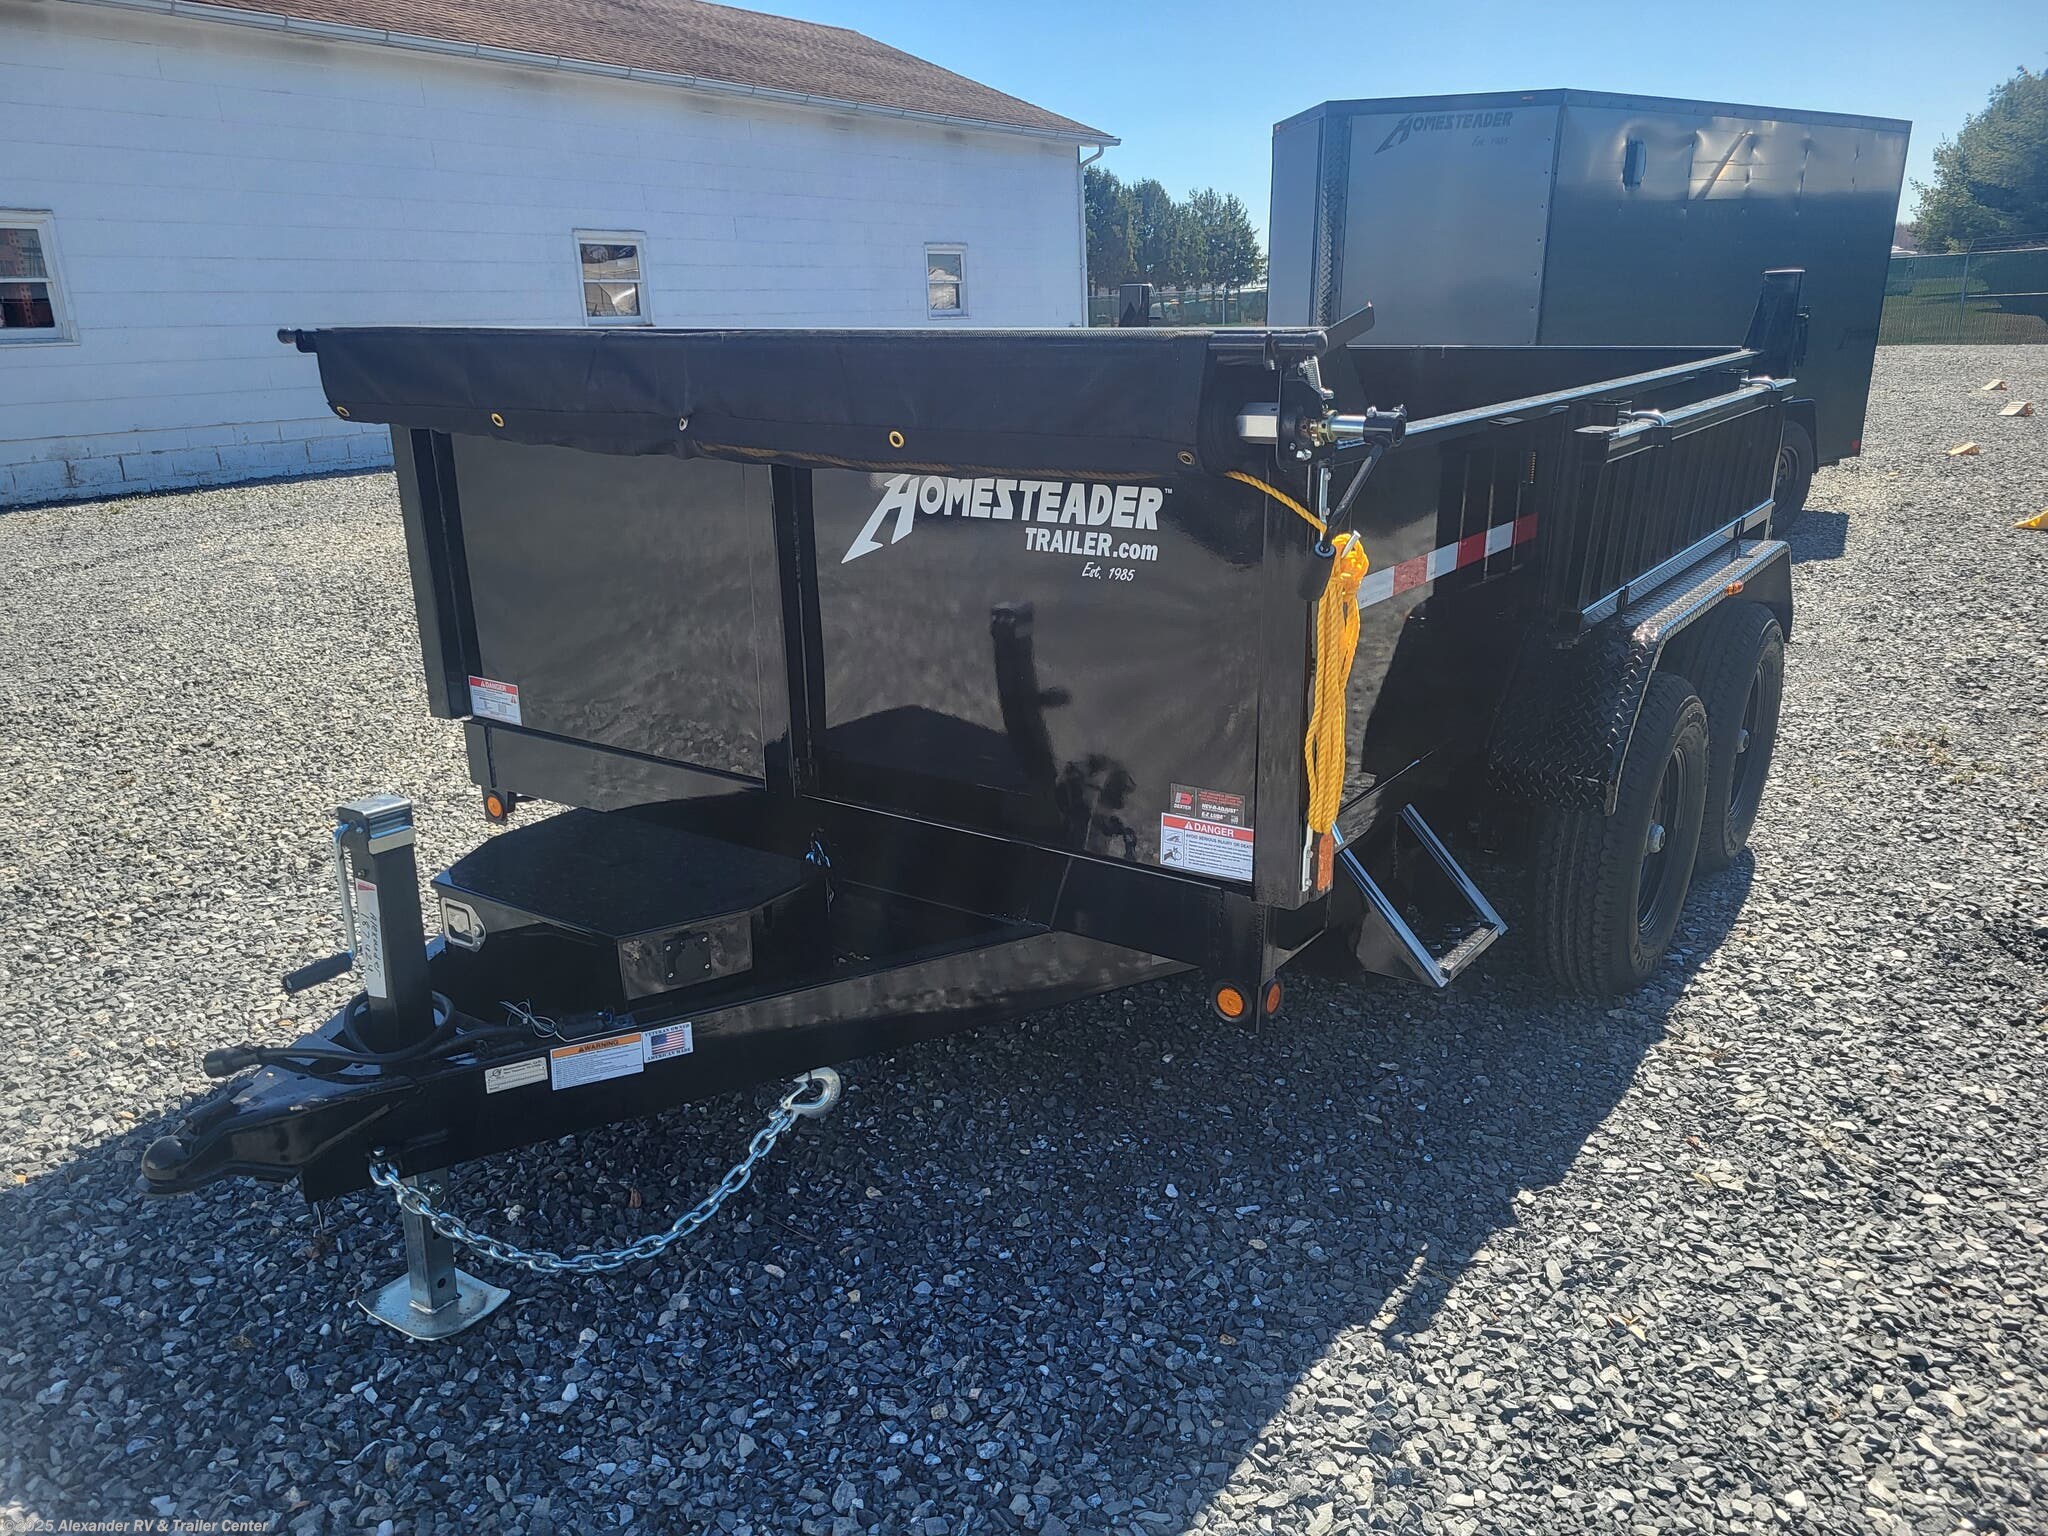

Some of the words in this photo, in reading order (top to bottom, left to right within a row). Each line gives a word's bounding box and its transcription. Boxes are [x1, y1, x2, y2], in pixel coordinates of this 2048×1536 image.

[1374, 112, 1513, 154] HOMESTEADER
[842, 474, 1164, 563] HOMESTEADER
[1025, 527, 1159, 561] TRAILER.com
[1108, 567, 1135, 582] 1985
[1194, 822, 1234, 838] DANGER
[645, 1028, 669, 1037] VETERAN
[584, 1039, 619, 1052] WARNING
